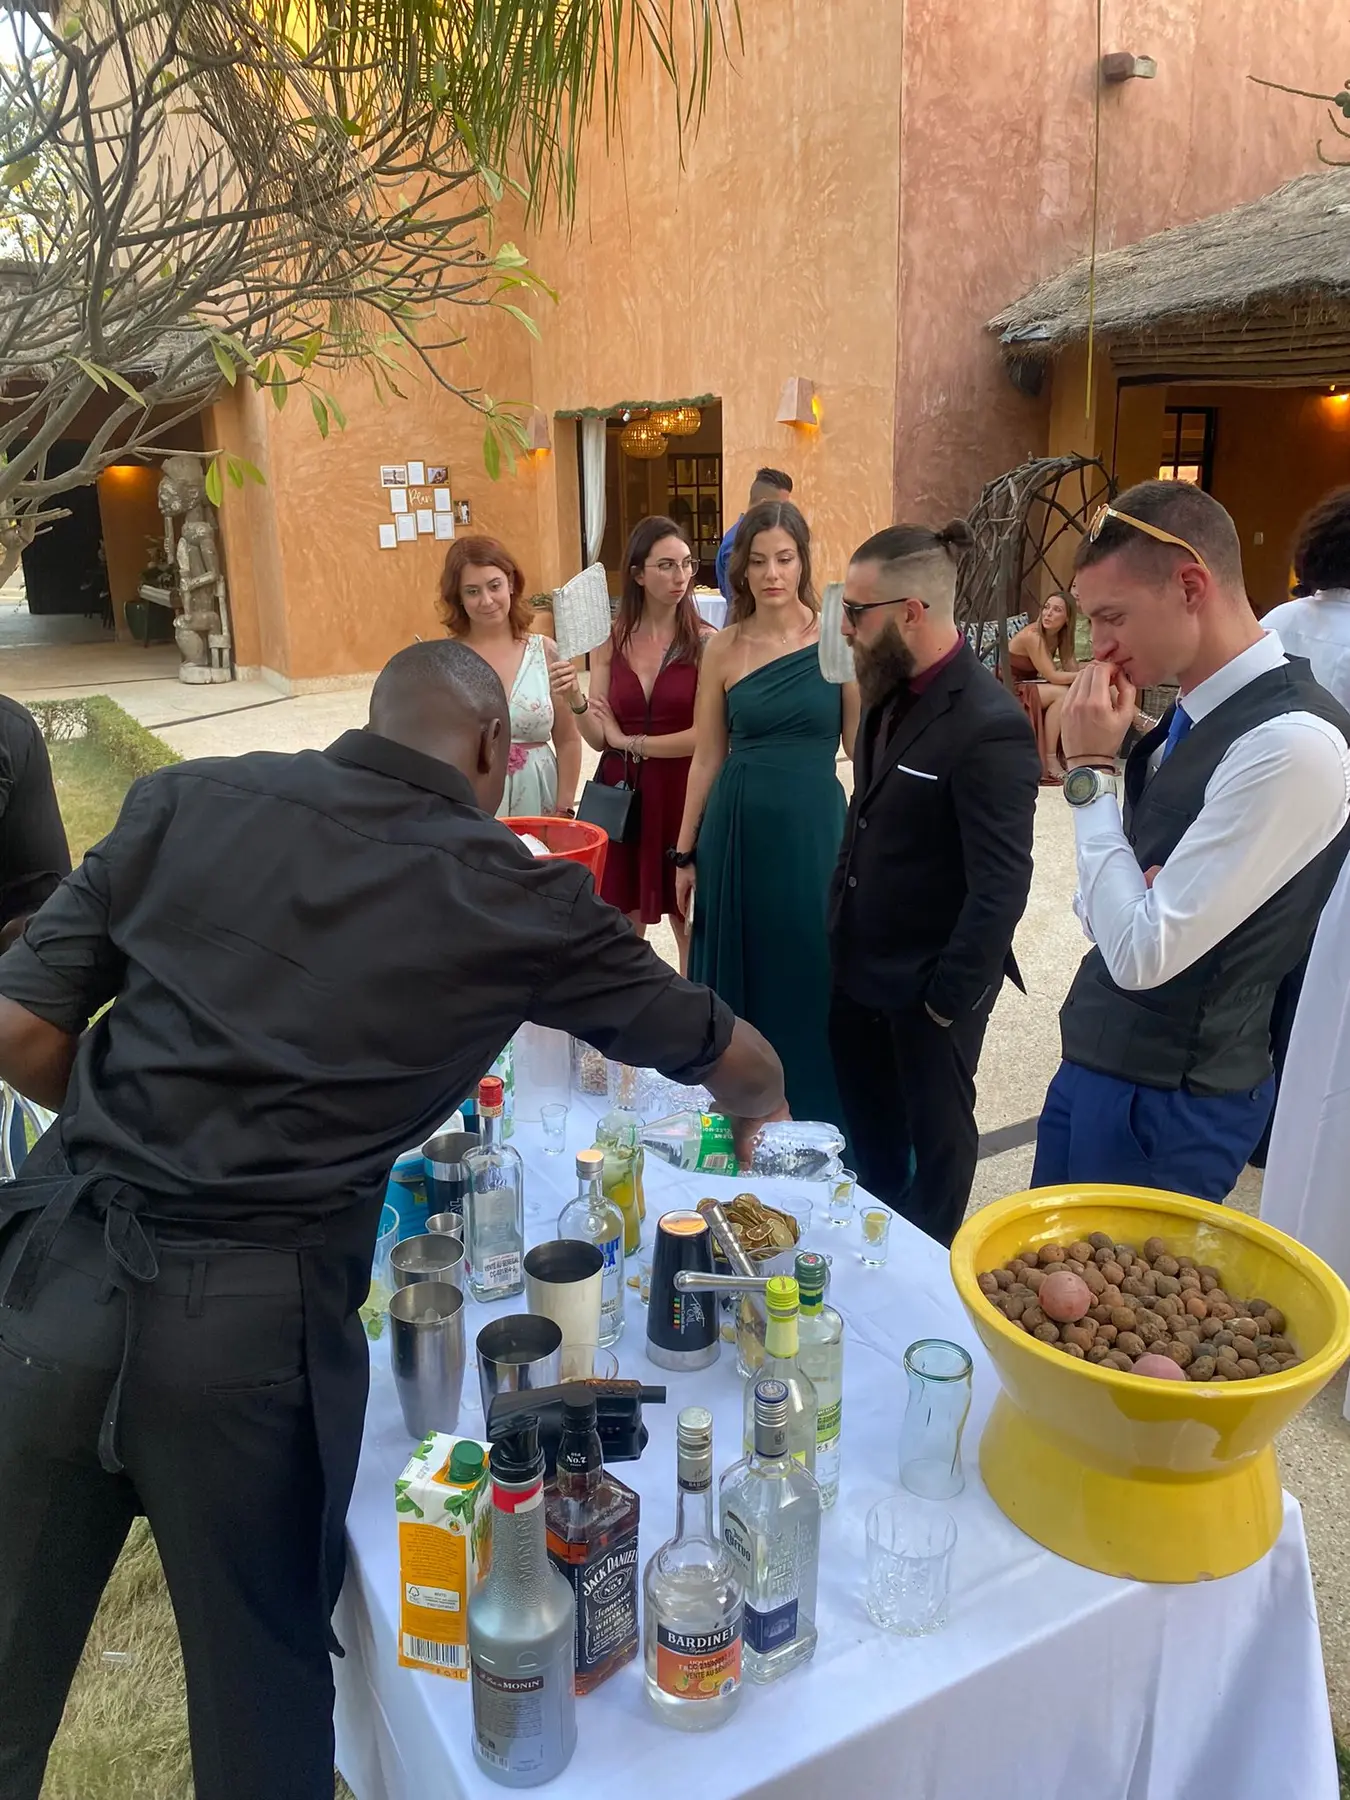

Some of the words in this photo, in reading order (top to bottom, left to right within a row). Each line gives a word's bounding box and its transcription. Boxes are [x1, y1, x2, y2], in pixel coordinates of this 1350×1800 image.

[408, 488, 433, 507] Plan
[582, 1565, 607, 1596] JACK
[607, 1549, 638, 1574] DANIEL
[595, 1602, 631, 1631] WHISKEY
[667, 1624, 736, 1649] BARDINET
[502, 1680, 541, 1689] MONIN
